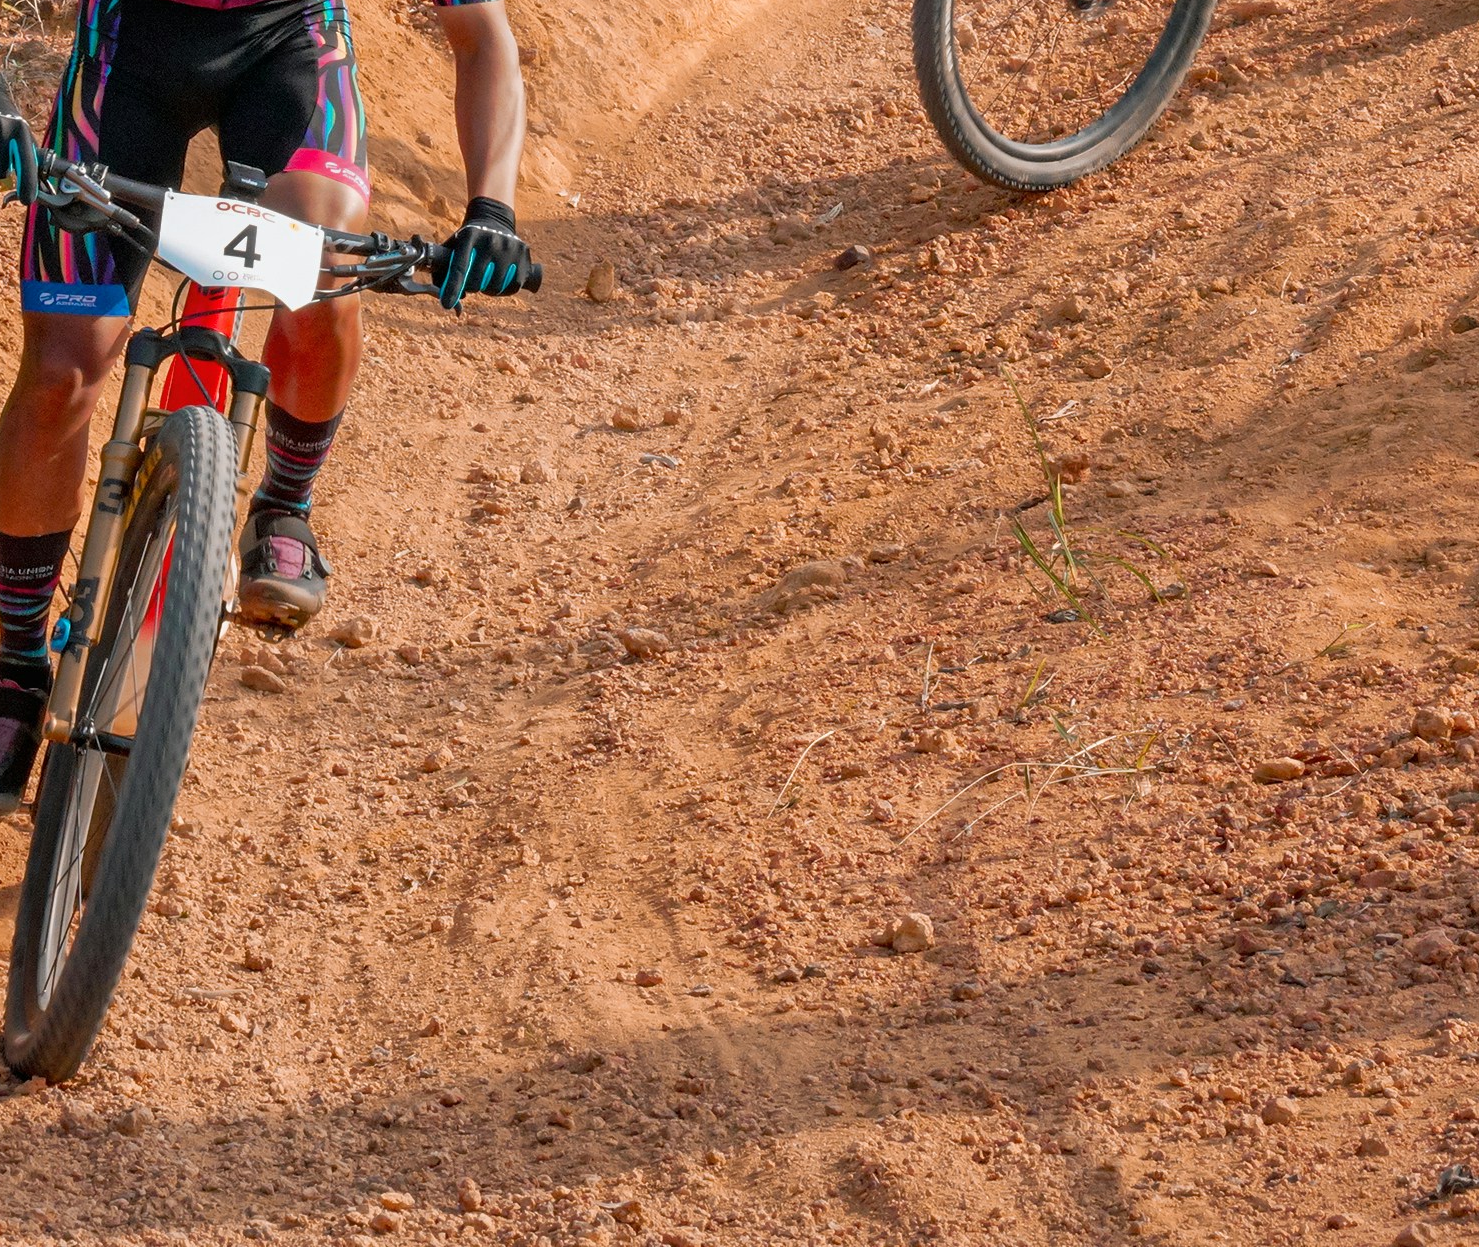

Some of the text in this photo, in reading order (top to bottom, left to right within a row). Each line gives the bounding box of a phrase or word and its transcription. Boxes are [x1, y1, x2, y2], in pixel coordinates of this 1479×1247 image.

[216, 201, 276, 224] OCBC
[224, 224, 262, 269] 4
[56, 293, 97, 303] PRO
[18, 565, 54, 575] UNION
